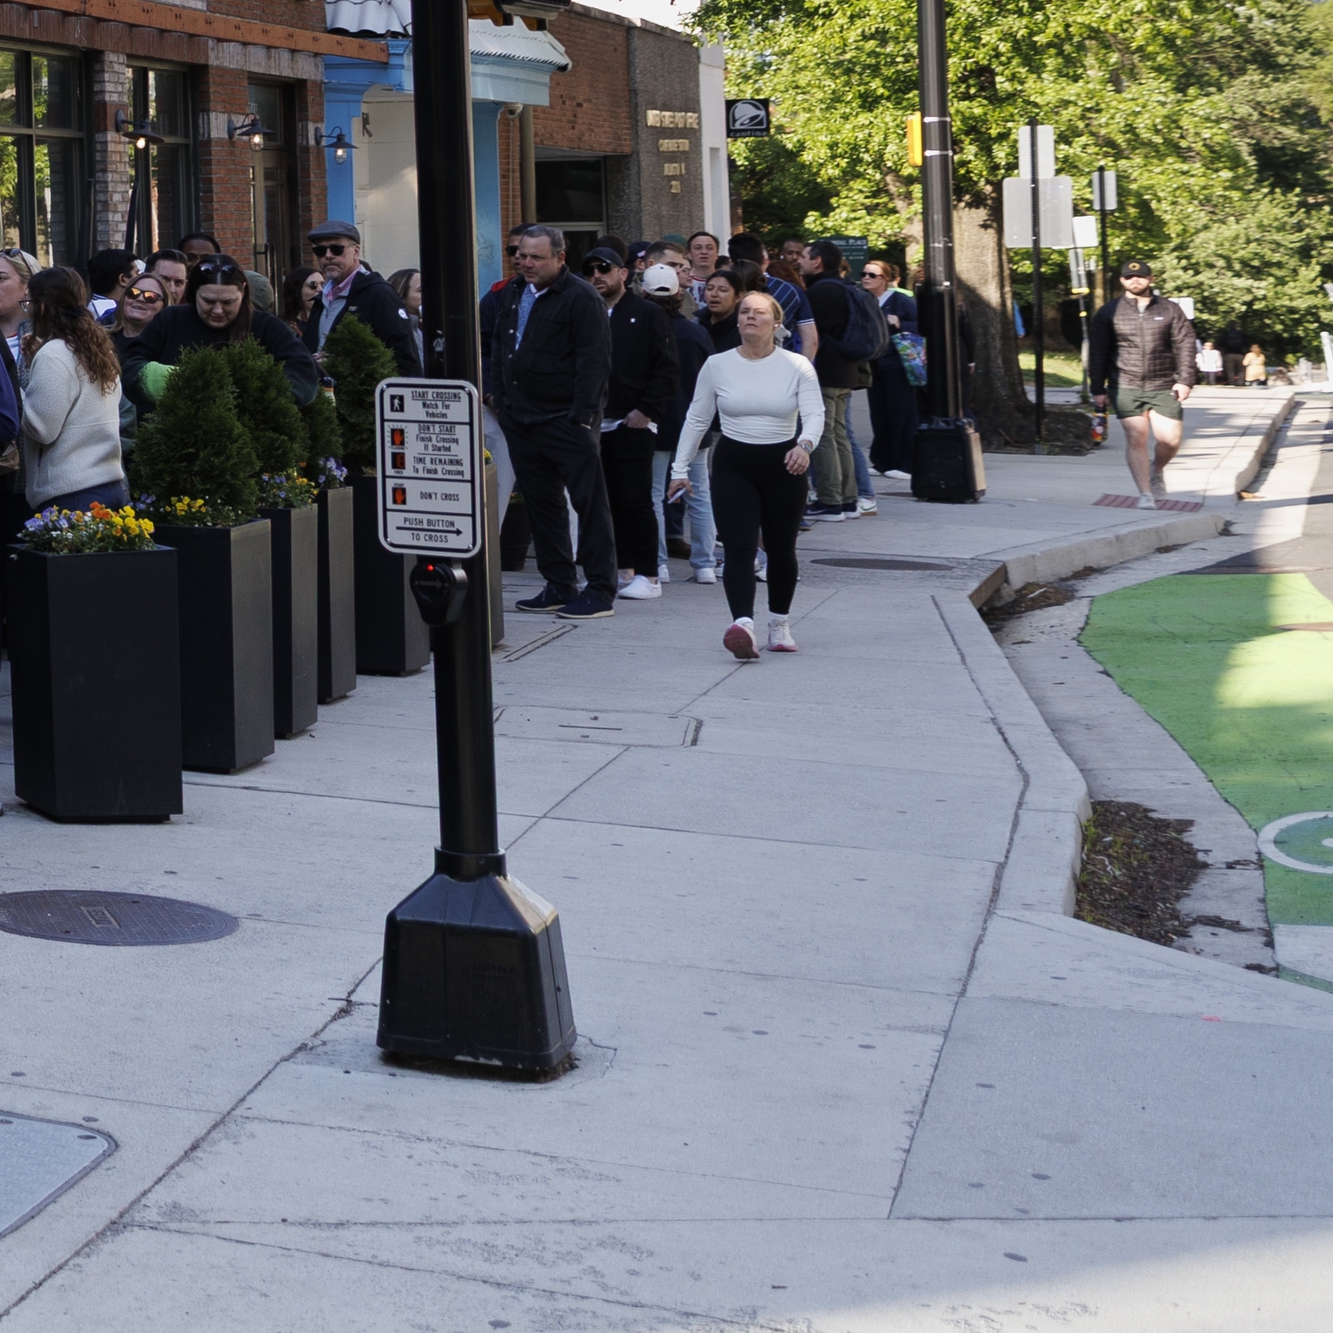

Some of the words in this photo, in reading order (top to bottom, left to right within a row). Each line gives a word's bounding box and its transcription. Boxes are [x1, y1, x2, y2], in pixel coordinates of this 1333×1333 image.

[411, 391, 428, 399] START
[431, 391, 461, 400] CROSSING
[442, 401, 451, 410] For
[425, 410, 448, 419] Vehicles
[418, 424, 435, 432] DON'T
[439, 425, 456, 433] START
[416, 434, 432, 442] Finish
[436, 434, 459, 445] Crossing
[431, 444, 451, 452] Started
[413, 456, 426, 465] TIME
[430, 457, 463, 466] REMAINING
[442, 467, 464, 478] Crossing
[420, 491, 438, 500] DON'T
[440, 493, 460, 501] CROSS
[403, 517, 424, 526] PUSH
[426, 518, 455, 528] BUTTON
[411, 533, 420, 541] TO
[424, 533, 449, 543] CROSS
